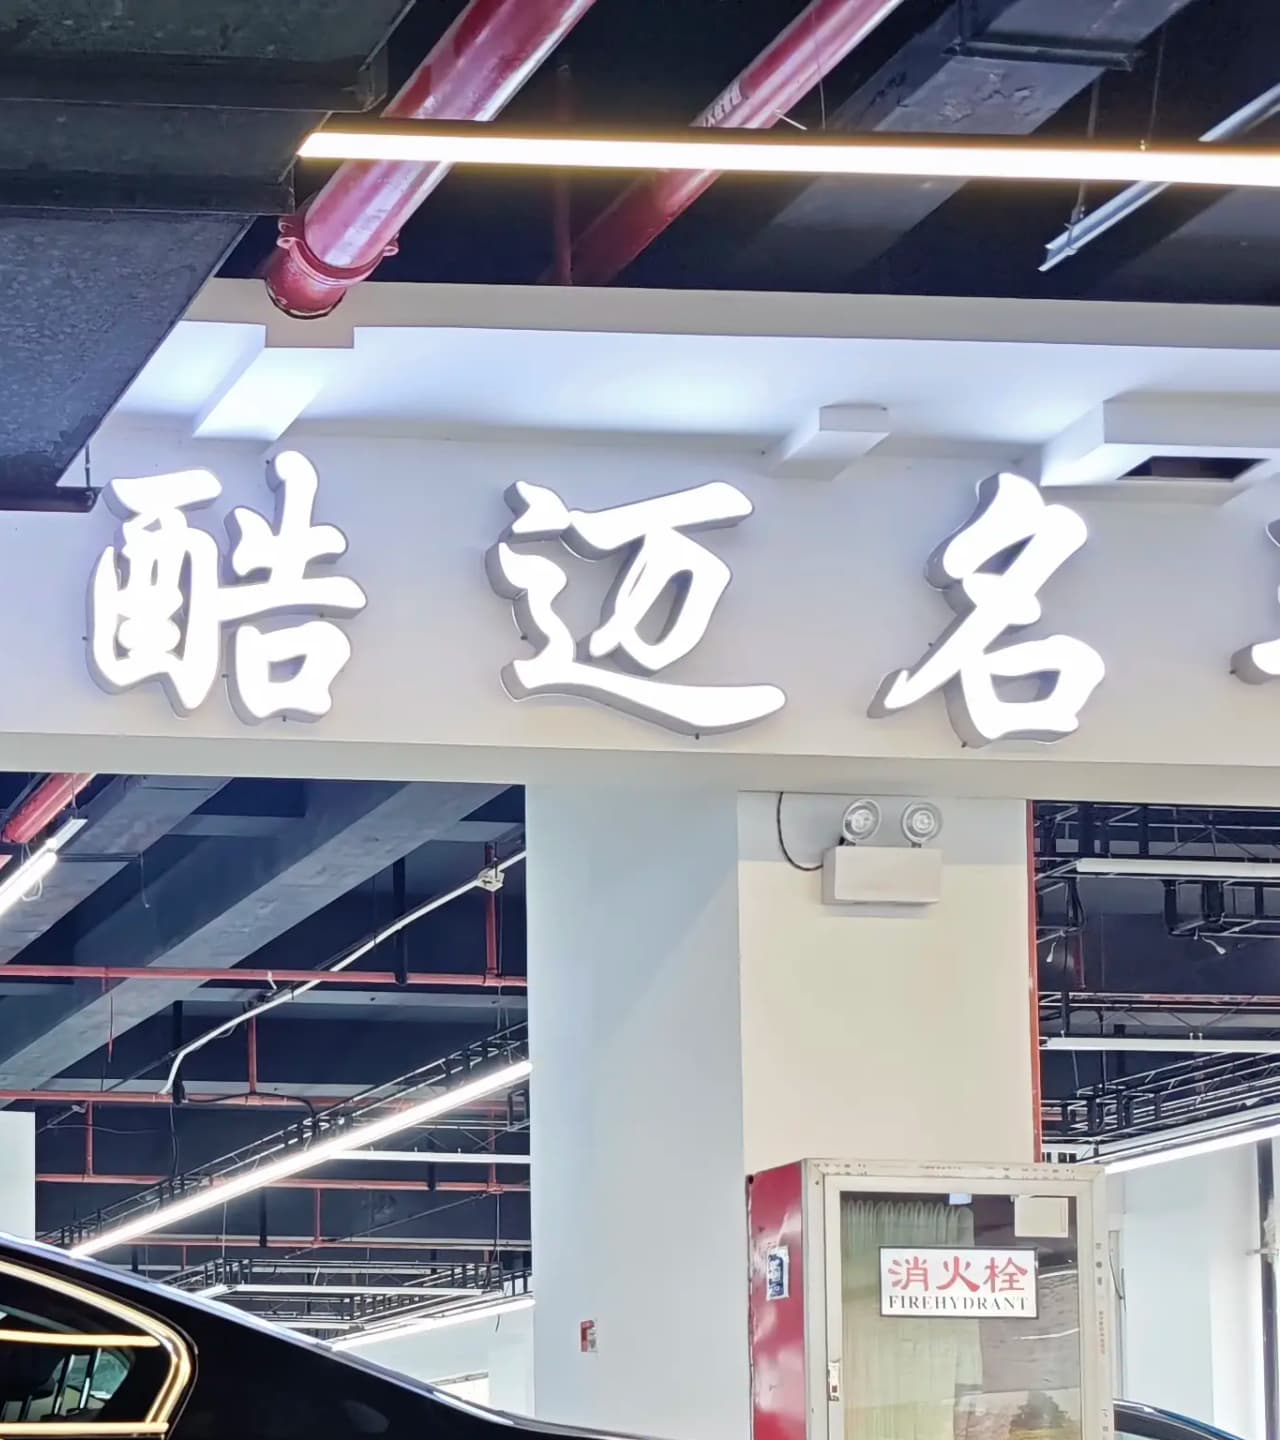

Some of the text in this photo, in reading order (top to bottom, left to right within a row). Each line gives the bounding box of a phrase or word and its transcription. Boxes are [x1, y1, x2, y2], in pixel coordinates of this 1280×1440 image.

[88, 450, 1280, 747] 酷迈名
[888, 1256, 1028, 1293] 消火栓
[889, 1295, 1028, 1310] FIREHYDRANT
